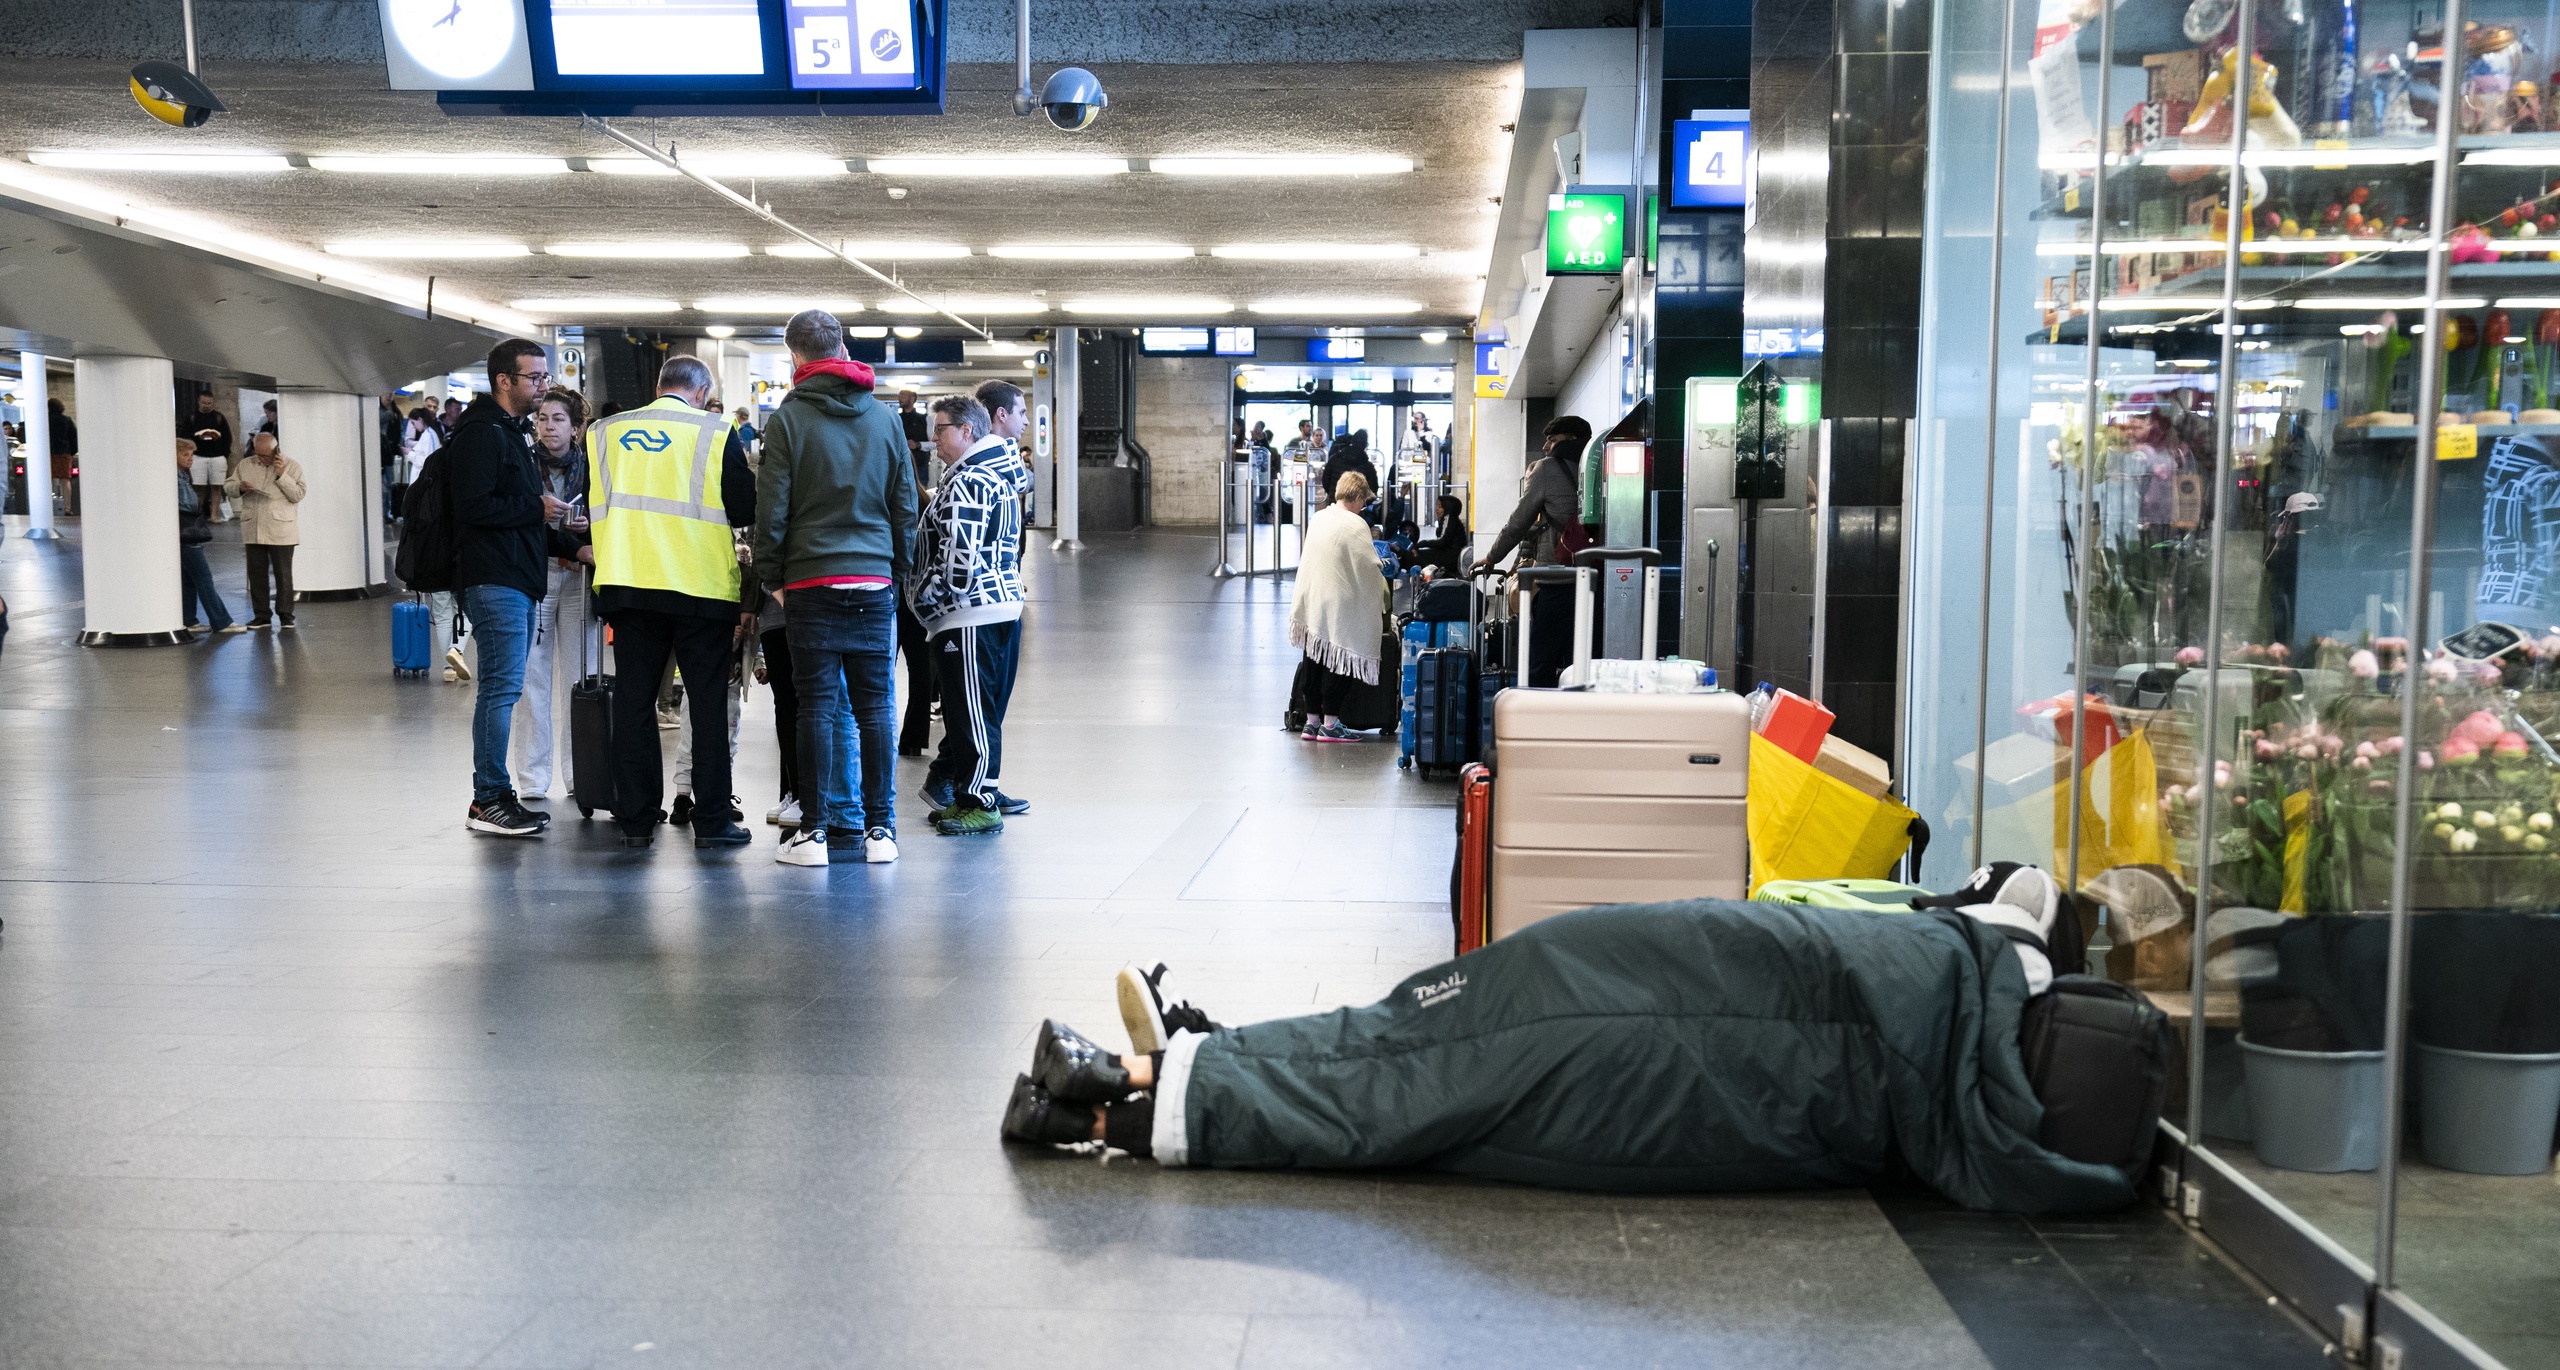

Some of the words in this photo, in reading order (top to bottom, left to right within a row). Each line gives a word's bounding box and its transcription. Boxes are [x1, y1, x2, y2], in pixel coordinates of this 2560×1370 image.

[1705, 151, 1726, 179] 4
[1565, 199, 1585, 209] AED
[1564, 250, 1607, 265] AED
[1412, 971, 1468, 1001] TRAIL
